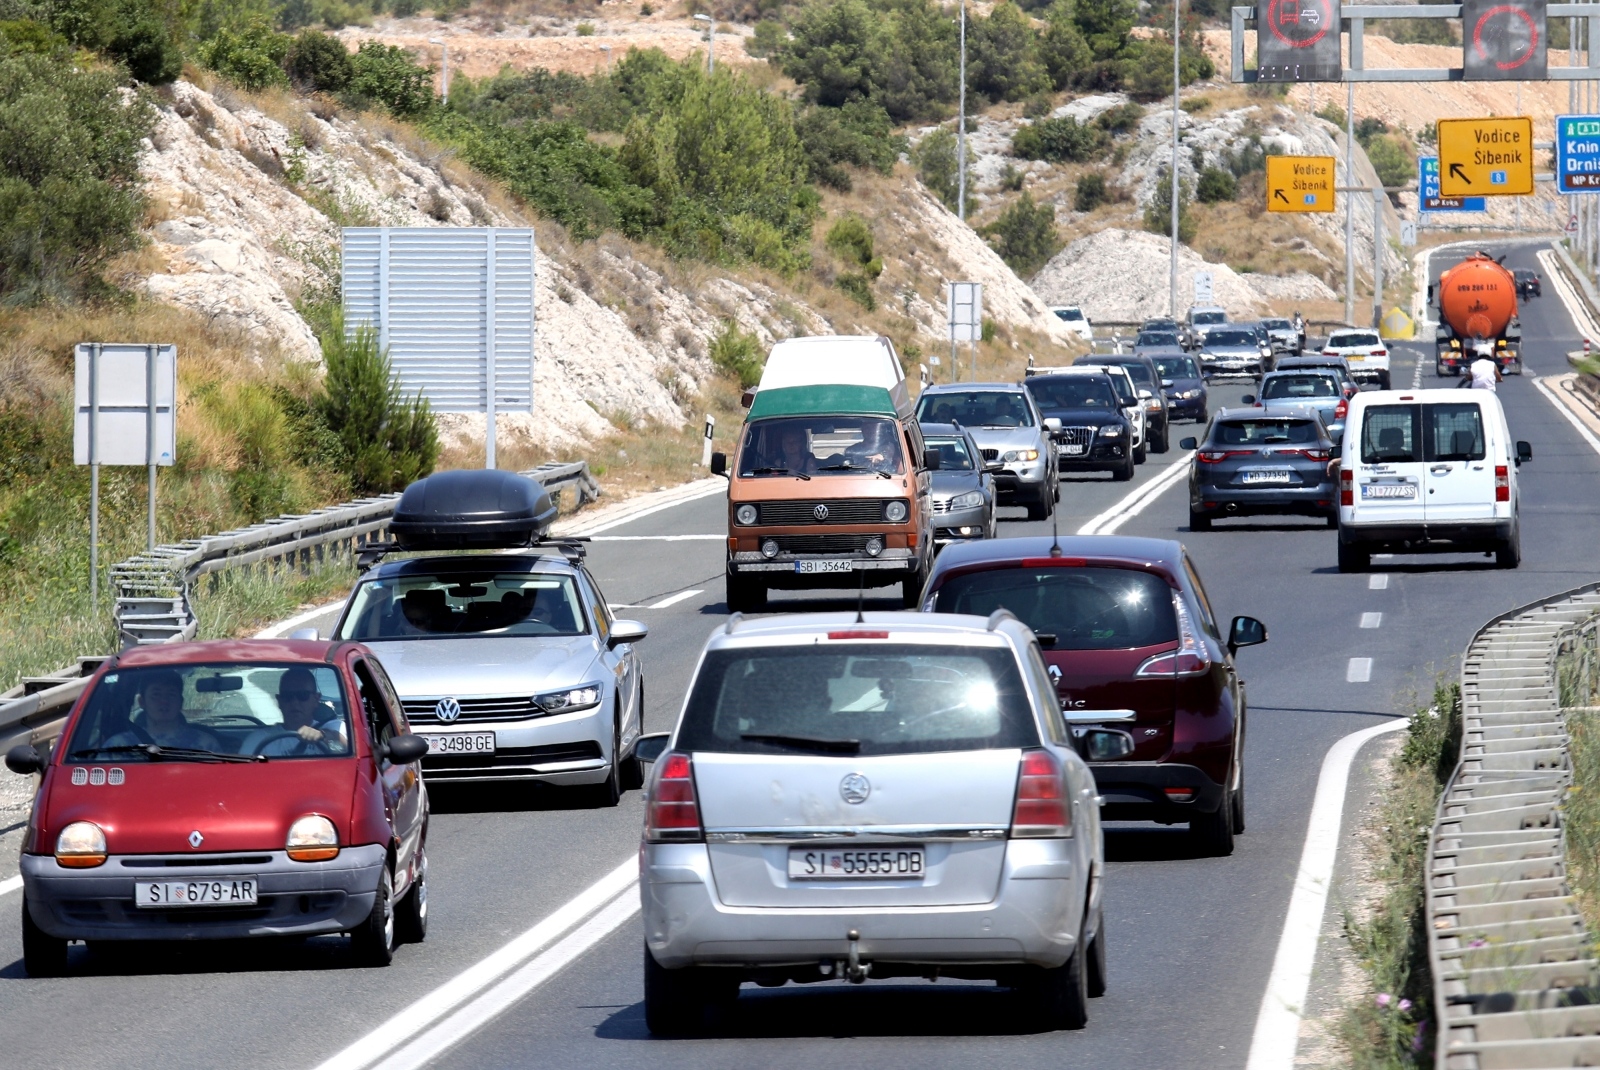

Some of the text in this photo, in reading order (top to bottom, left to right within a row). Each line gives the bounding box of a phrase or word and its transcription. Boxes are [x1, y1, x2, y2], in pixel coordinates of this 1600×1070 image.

[1474, 128, 1520, 144] Vodice
[1567, 140, 1599, 154] Knin
[1474, 147, 1522, 165] Šibenik
[1293, 164, 1326, 175] Vodice
[1293, 178, 1328, 190] Šibenik
[1572, 175, 1587, 185] NP
[801, 561, 851, 572] SBI 35642
[187, 881, 253, 902] 679-AR
